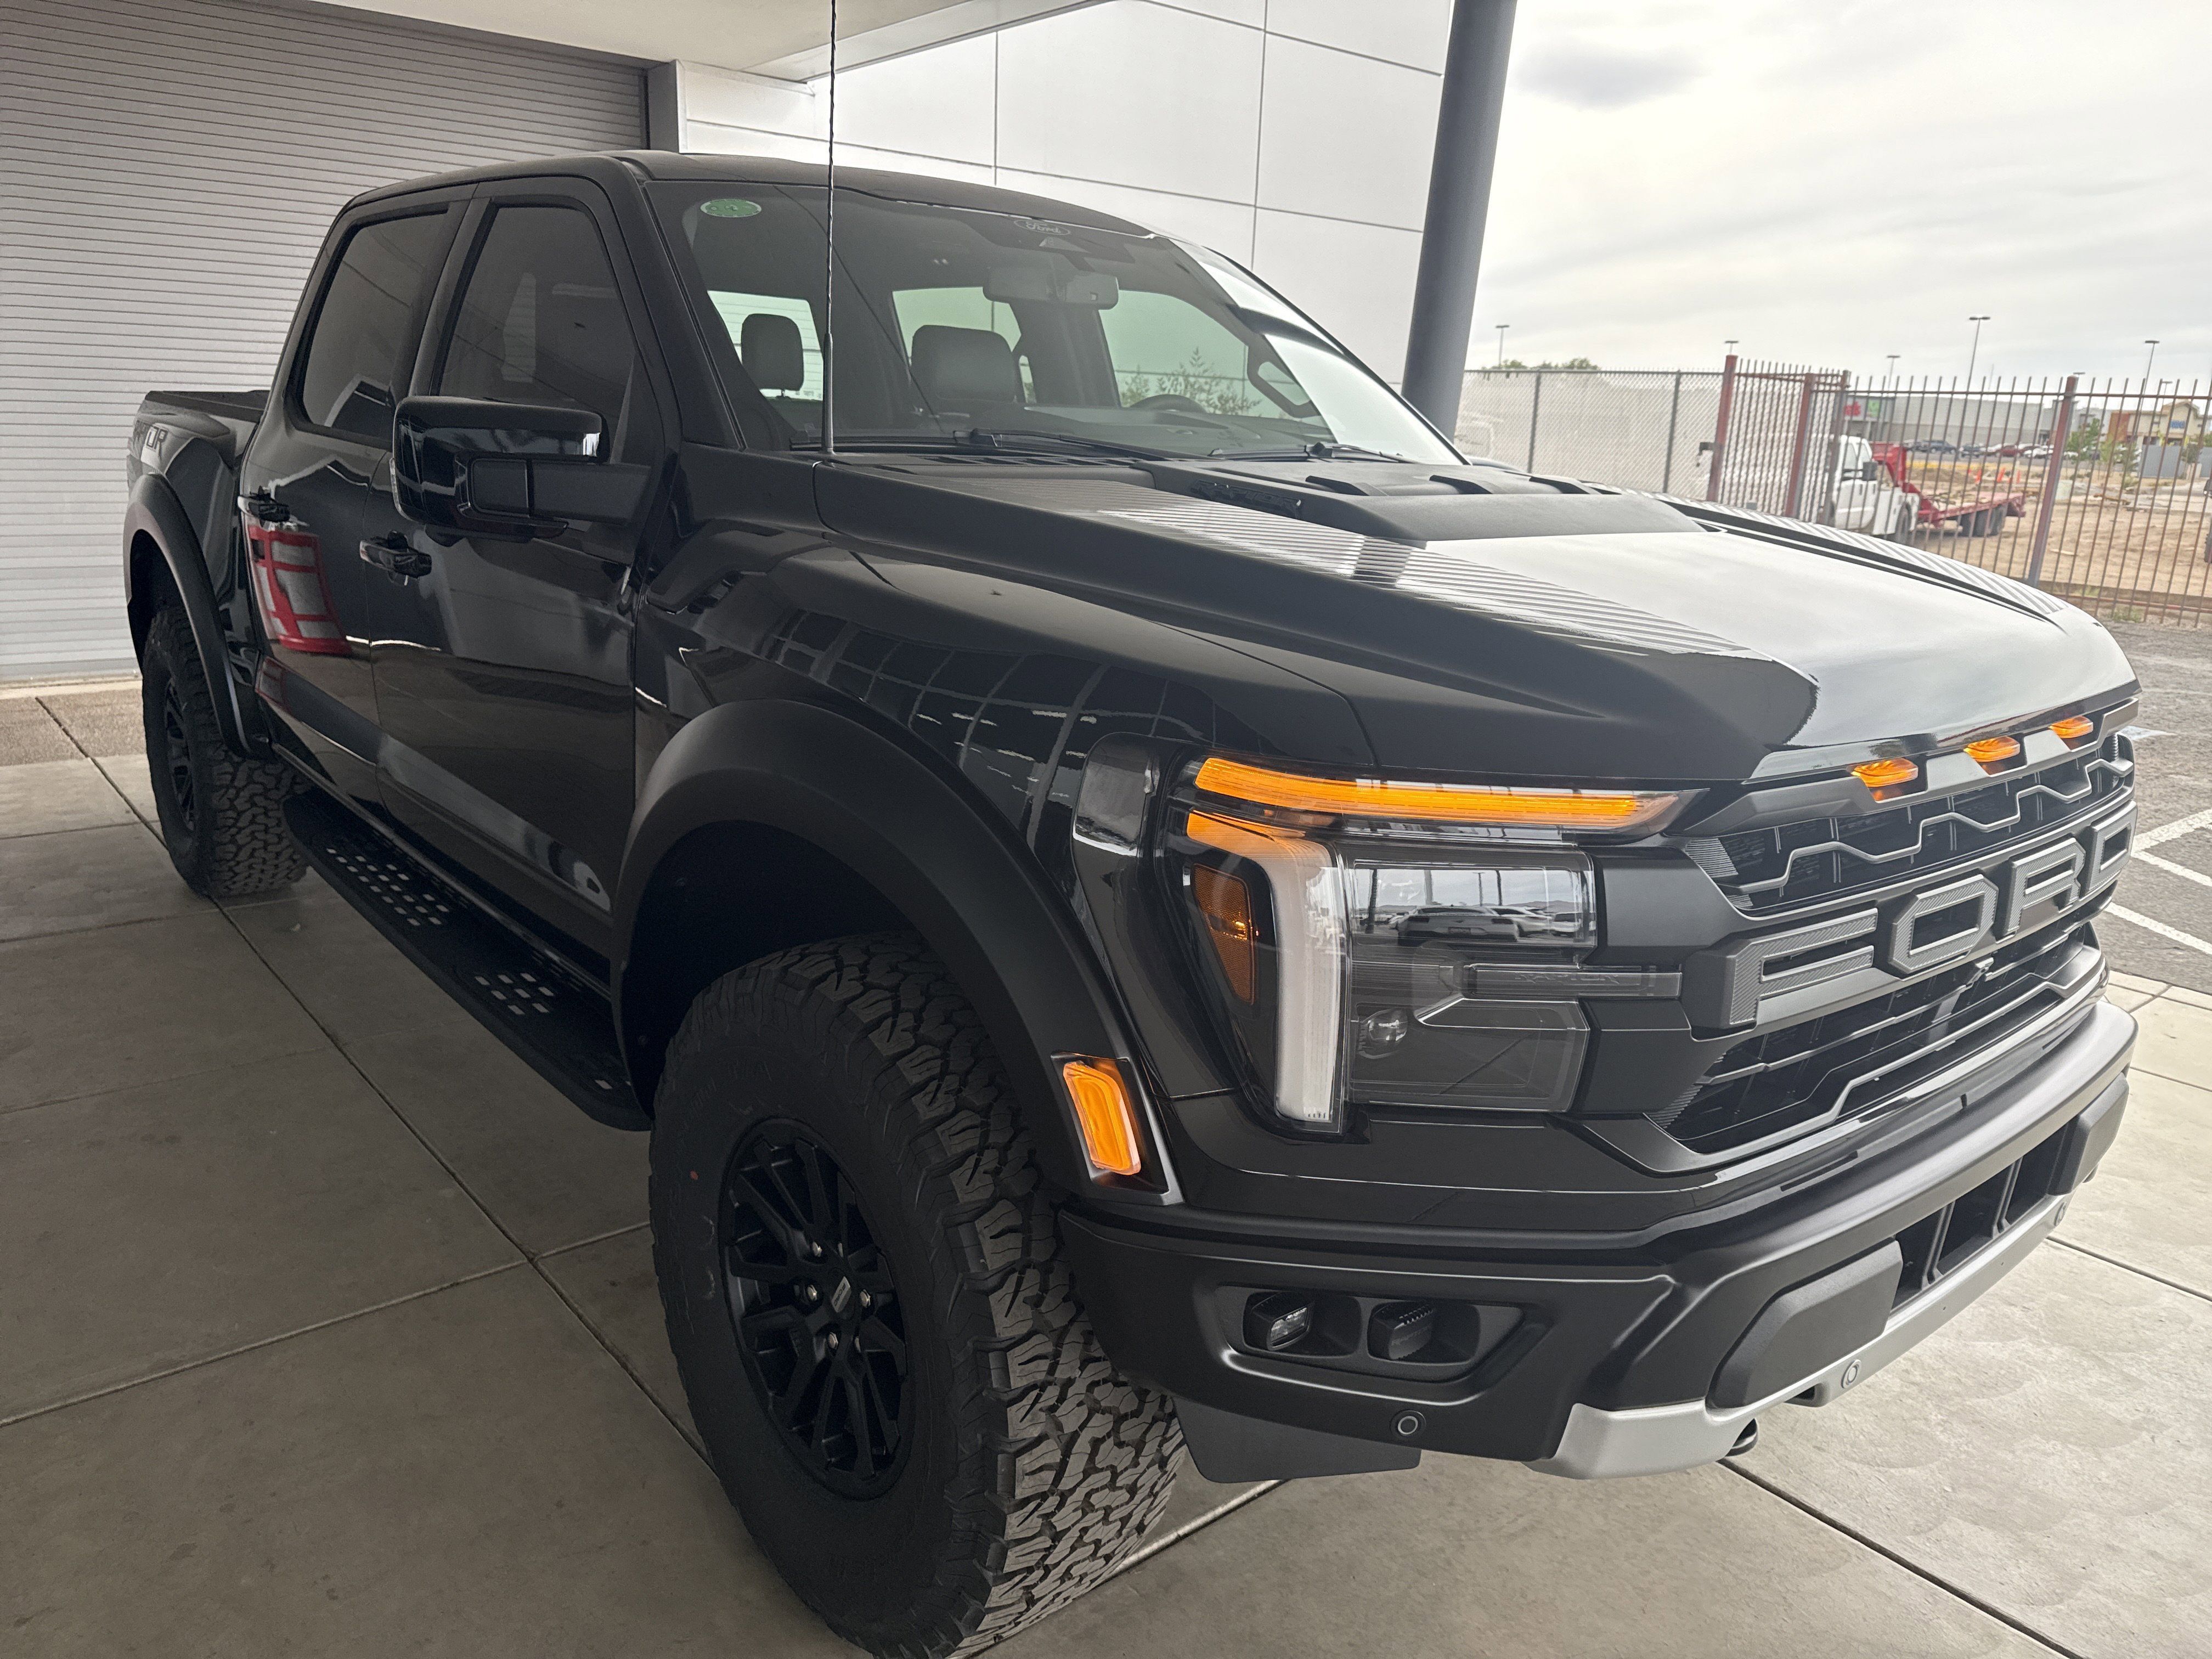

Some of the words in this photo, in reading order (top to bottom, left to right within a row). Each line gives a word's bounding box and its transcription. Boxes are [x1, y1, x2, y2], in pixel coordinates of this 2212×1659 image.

[1025, 221, 1062, 234] Ford
[1726, 800, 2138, 1026] FORD
[834, 1283, 846, 1307] FORD
